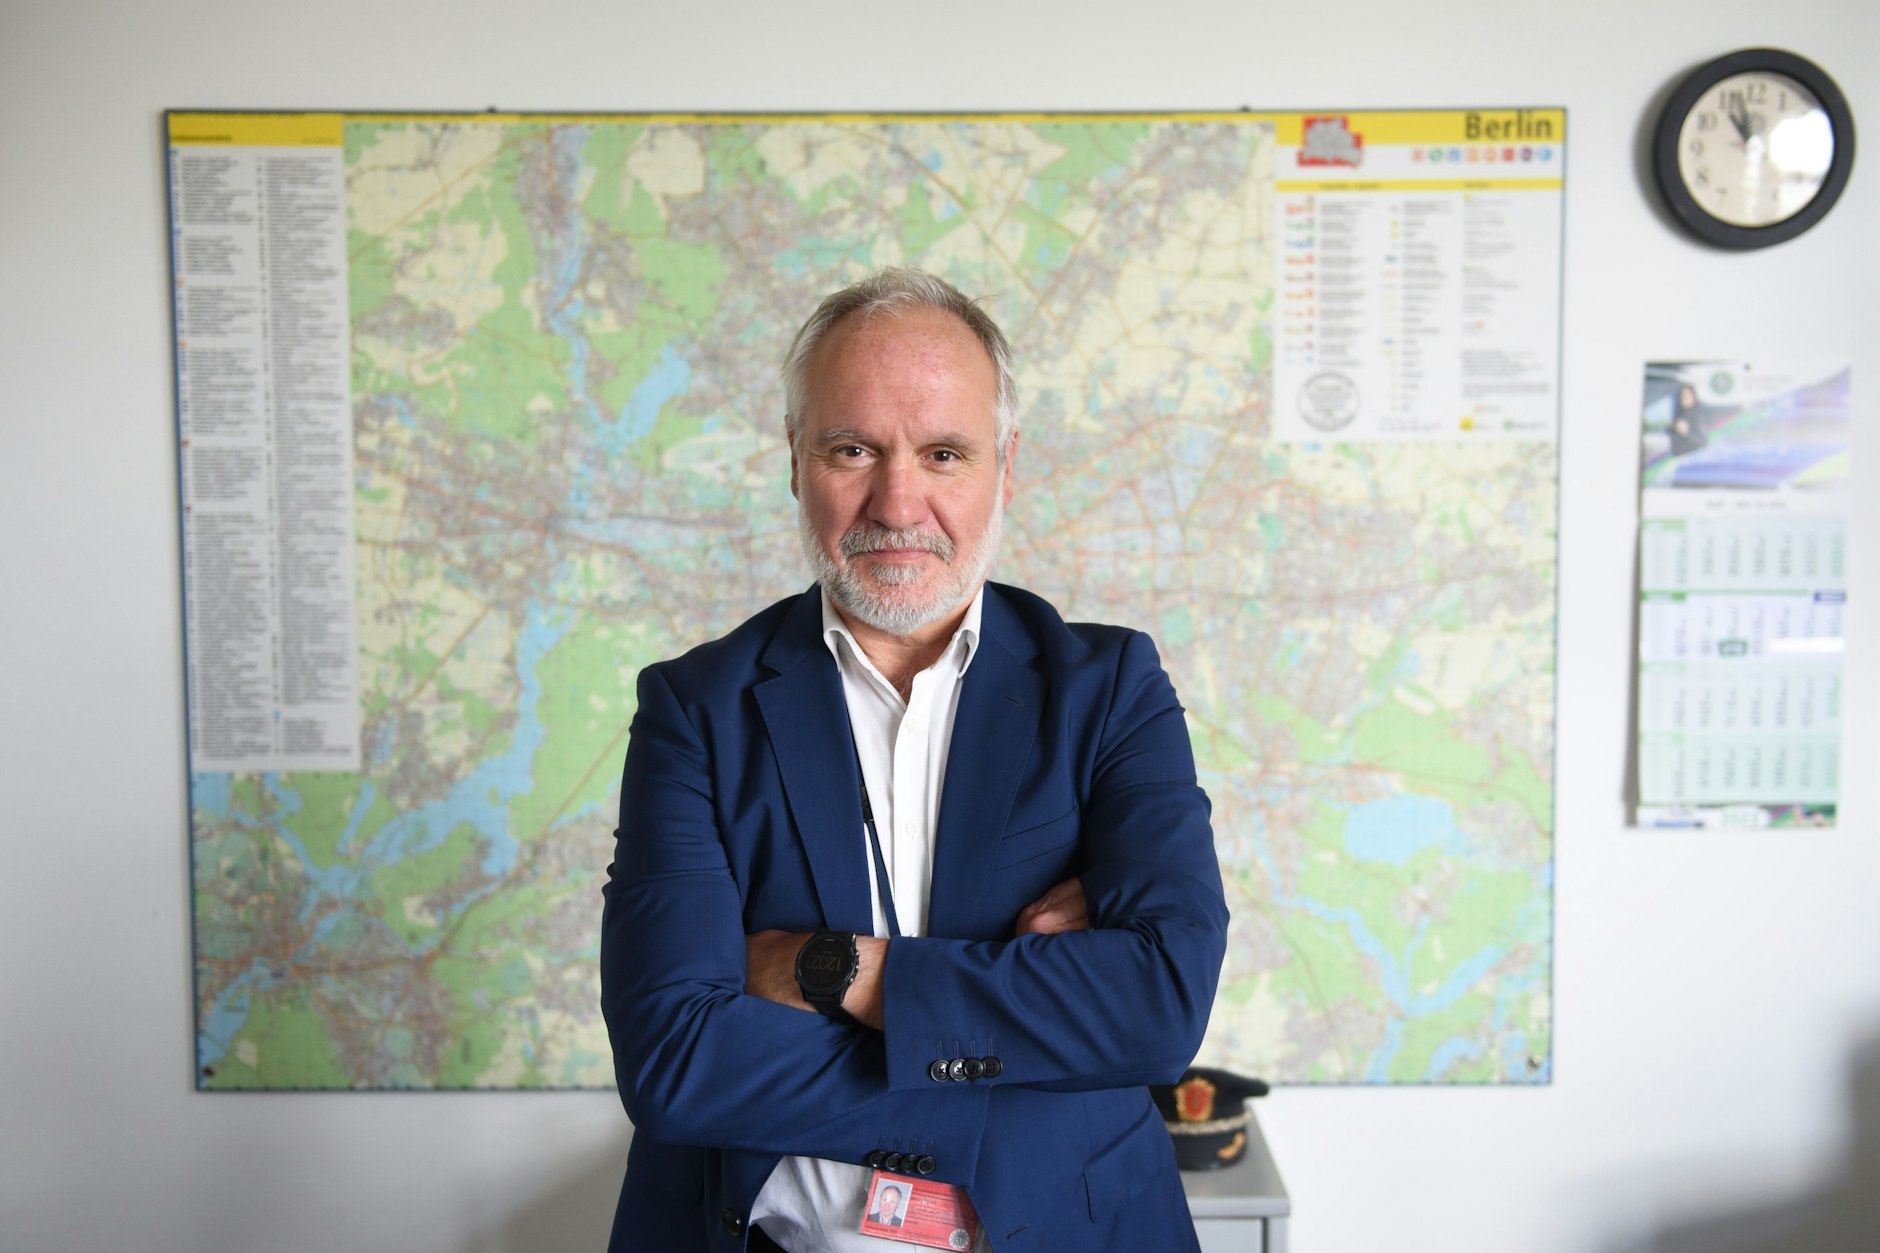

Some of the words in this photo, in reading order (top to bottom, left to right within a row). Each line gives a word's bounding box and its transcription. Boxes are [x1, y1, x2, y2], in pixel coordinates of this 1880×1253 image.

[1745, 83, 1767, 104] 12
[1778, 91, 1787, 111] 1
[1465, 109, 1552, 138] Berlin
[1696, 111, 1717, 130] 10
[1689, 138, 1703, 160] 9
[1695, 165, 1708, 186] 8
